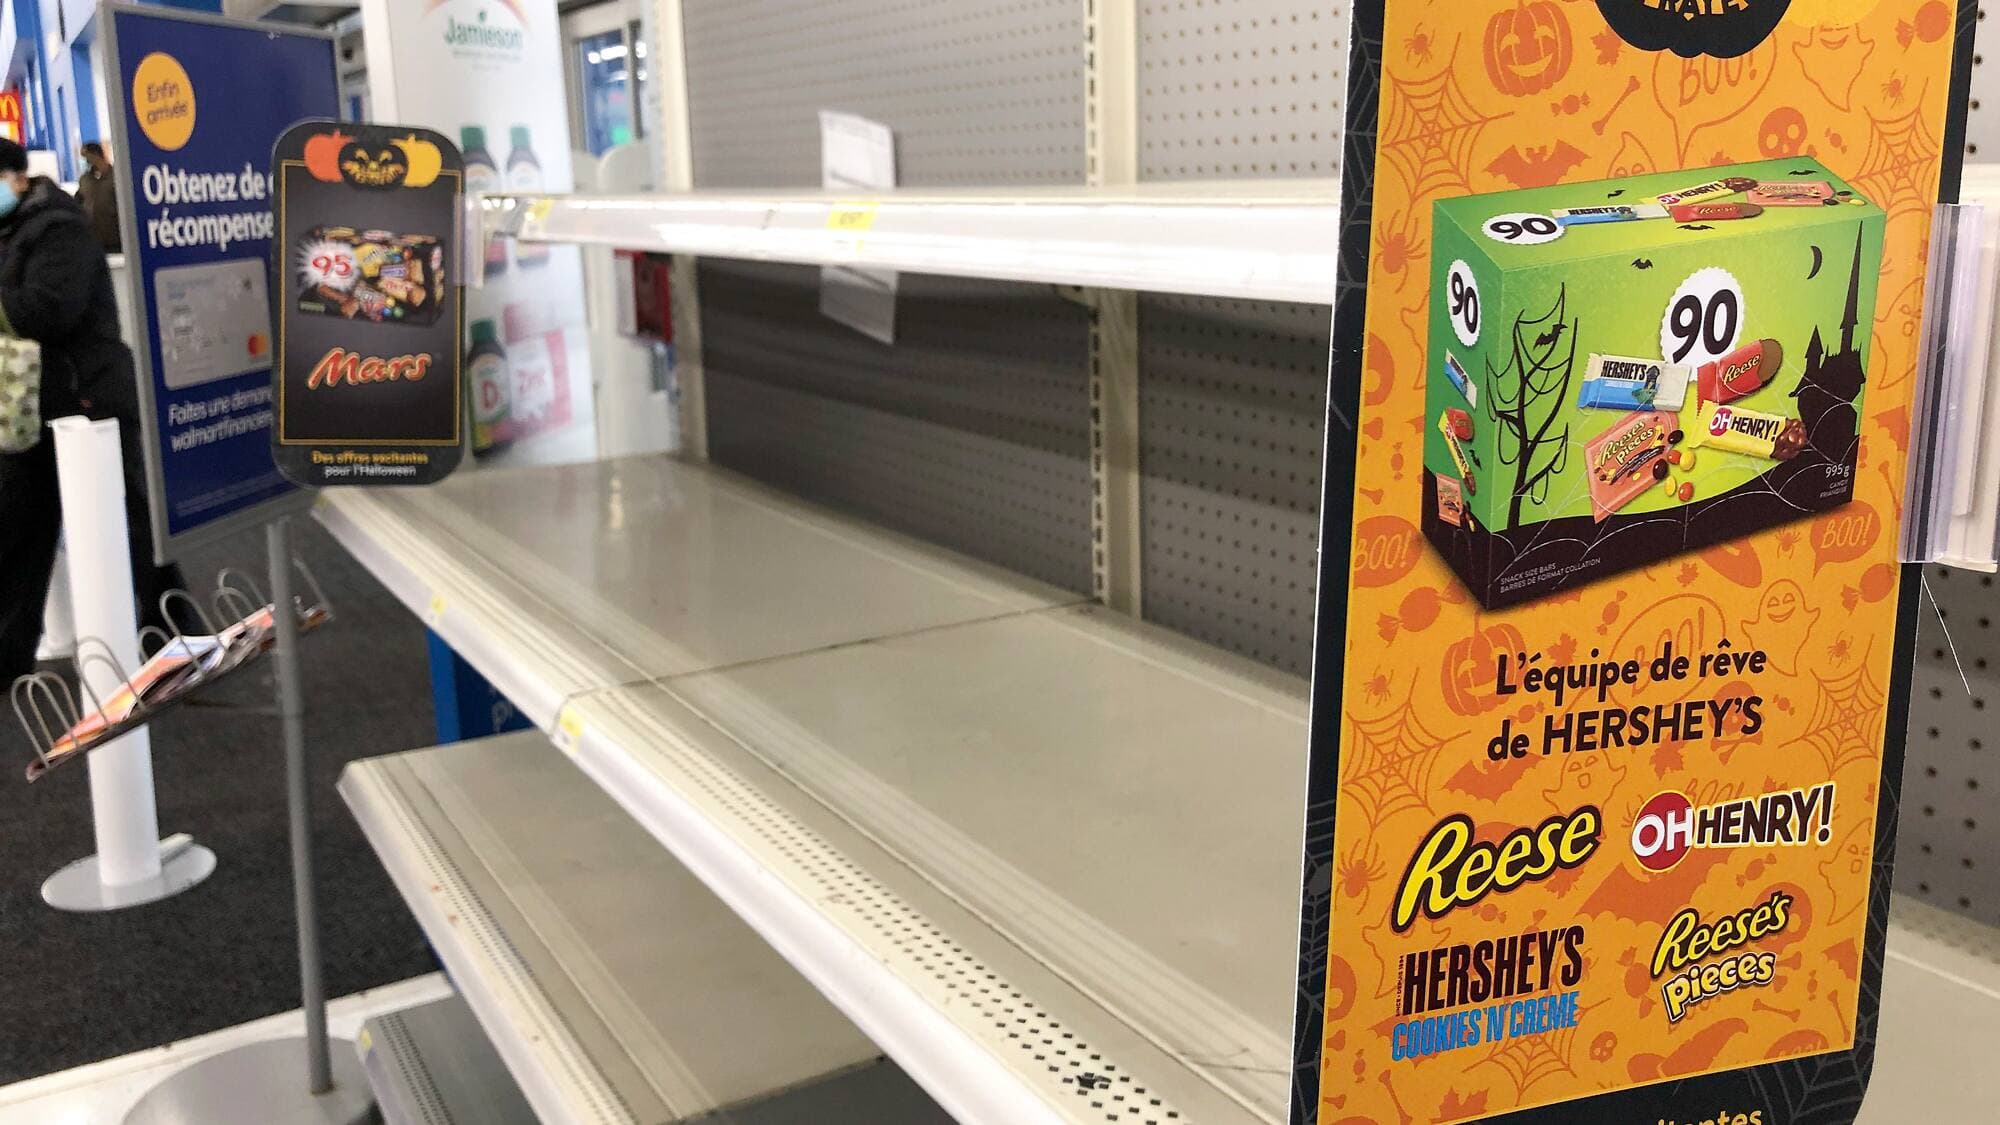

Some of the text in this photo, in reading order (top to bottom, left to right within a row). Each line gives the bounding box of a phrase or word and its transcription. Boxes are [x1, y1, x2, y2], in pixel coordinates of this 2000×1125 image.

[445, 17, 523, 49] Jamieson
[147, 81, 180, 103] Enfin
[147, 101, 188, 125] arrivée
[142, 163, 238, 205] Obtenez
[240, 161, 265, 200] de
[1490, 217, 1557, 240] 90
[312, 255, 353, 277] 95
[1451, 272, 1478, 334] 90
[1671, 289, 1738, 364] 90
[308, 346, 432, 390] Mars
[1601, 360, 1647, 381] HERSHEY'S
[1723, 354, 1760, 385] Reese
[168, 400, 208, 427] Faites
[208, 396, 231, 418] une
[1710, 413, 1780, 443] OH HENRY!
[312, 450, 334, 464] Des
[336, 450, 369, 464] offres
[325, 463, 416, 478] pour l'Halloween
[1825, 464, 1843, 478] 995
[1820, 512, 1873, 549] BOO!
[1500, 563, 1557, 585] SNACK SIZE BARS
[1500, 557, 1601, 593] BARRES DE FORMAT COLLATION
[1496, 638, 1767, 706] L'équipe de rêve
[1487, 696, 1763, 761] de HERSHEY'S
[1632, 783, 1835, 857] OH HENRY!
[1392, 806, 1602, 932] Reese
[1652, 892, 1793, 980] Reese's
[1403, 925, 1585, 1016] HERSHEY'S
[1391, 1008, 1482, 1061] COOKIES
[1509, 991, 1580, 1038] CREME
